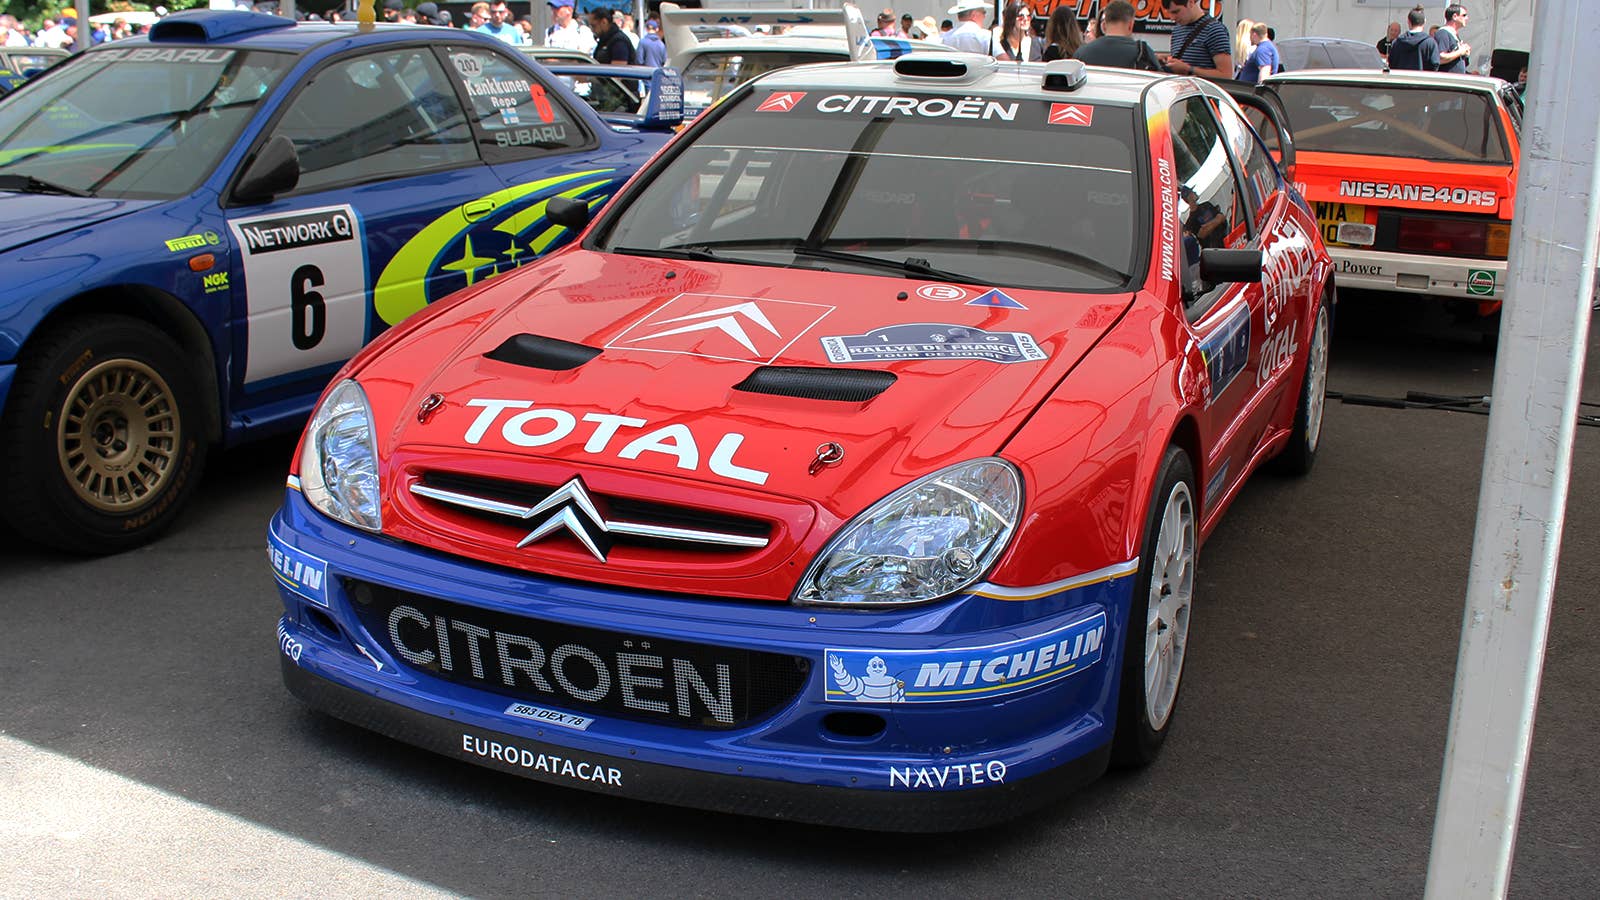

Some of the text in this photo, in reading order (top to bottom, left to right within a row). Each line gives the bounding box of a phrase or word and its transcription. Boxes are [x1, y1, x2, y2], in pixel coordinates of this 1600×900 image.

[93, 49, 236, 63] SUBARU
[457, 58, 480, 72] 202
[463, 78, 531, 96] Kankkunen
[490, 96, 518, 108] Repo
[529, 83, 555, 124] 6
[816, 95, 1019, 121] CITROËN
[495, 125, 566, 148] SUBARU
[332, 213, 352, 237] Q
[1157, 157, 1173, 282] WWW.CITROEN.COM
[203, 271, 229, 288] NGK
[1343, 260, 1382, 276] Power
[290, 264, 326, 351] 6
[849, 343, 1019, 356] RALLYE DE FRANCE
[1018, 335, 1041, 359] 2005
[1256, 319, 1298, 389] TOTAL
[464, 398, 769, 485] TOTAL
[387, 604, 735, 724] CITROËN
[914, 625, 1104, 688] MICHELIN
[513, 705, 585, 726] 583 DEX 78
[462, 734, 623, 787] EURODATACAR
[889, 760, 1007, 788] NAVTEQ
